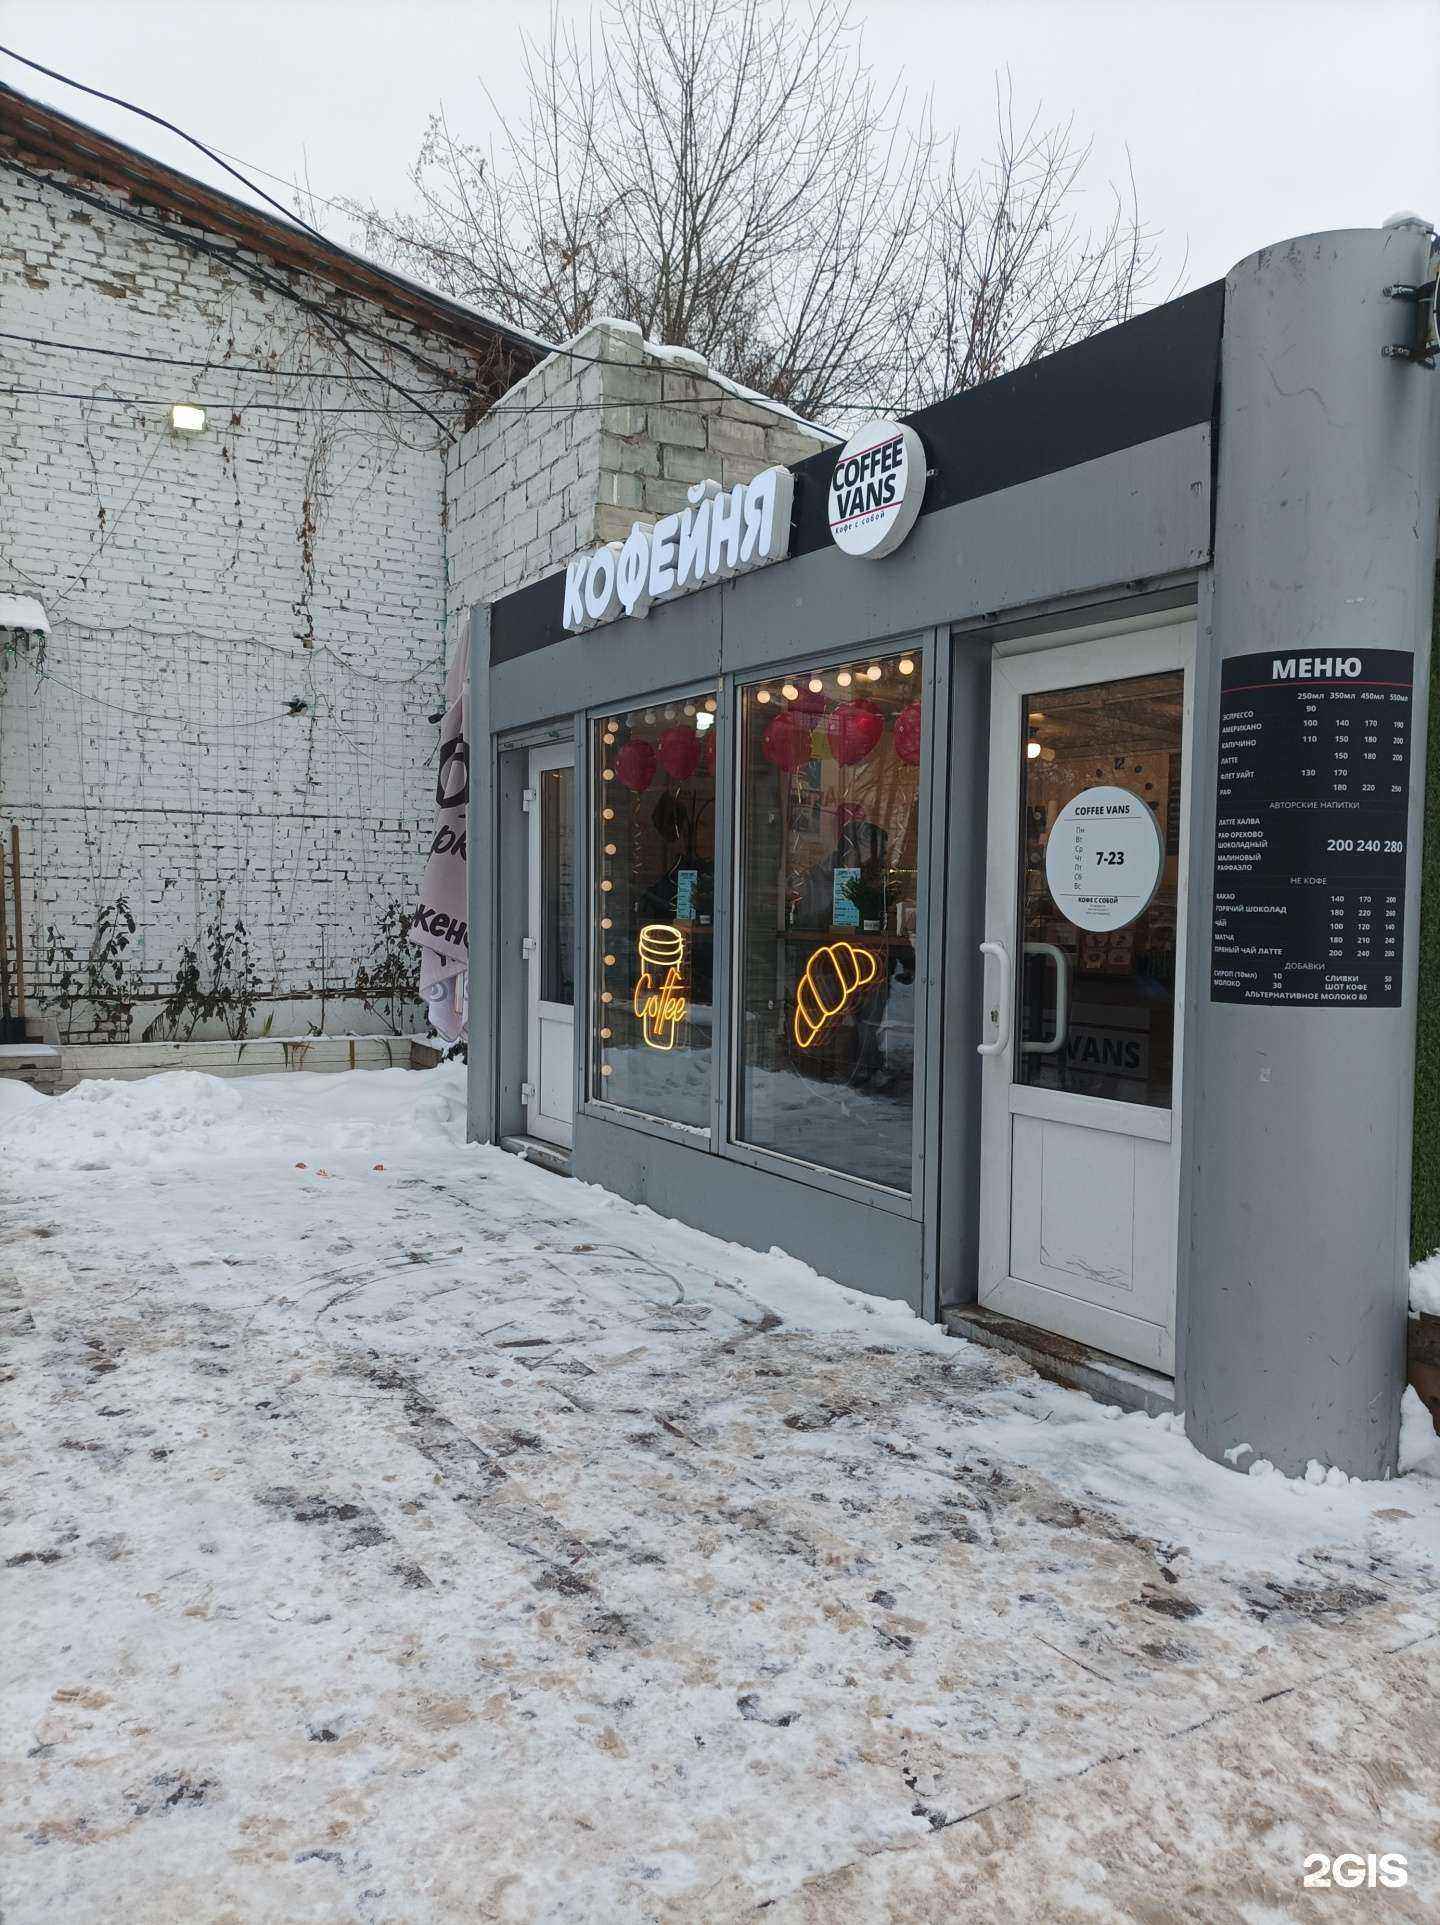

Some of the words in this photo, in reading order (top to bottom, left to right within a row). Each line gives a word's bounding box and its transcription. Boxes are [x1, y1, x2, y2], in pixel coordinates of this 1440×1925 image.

[832, 437, 904, 491] COFFEE
[836, 473, 897, 519] VANS
[562, 465, 793, 631] КОФЕЙНЯ
[1272, 657, 1362, 679] МЕНЮ
[1297, 692, 1325, 700] 250мл
[1329, 692, 1356, 700] 350мл
[1360, 692, 1385, 701] 450мл
[1222, 710, 1254, 720] ЭСПРЕССО
[1222, 723, 1262, 733] АМЕРИКАНО
[1336, 719, 1350, 727] 140
[1302, 735, 1317, 743] 110
[1335, 735, 1349, 743] 150
[1393, 737, 1404, 745] 200
[1221, 756, 1238, 765] ЛАТТЕ
[1334, 752, 1348, 760] 150
[1392, 754, 1403, 762] 200
[1269, 801, 1318, 809] АВТОРСКИЕ
[1319, 801, 1360, 809] НАПИТКИ
[1075, 806, 1104, 816] COFFEE
[1106, 805, 1130, 815] VANS
[1236, 817, 1260, 825] ХАЛВА
[1218, 840, 1268, 849] ШОКОЛАДНЫЙ
[1327, 839, 1354, 851] 200
[1357, 840, 1381, 852] 240
[1383, 841, 1403, 853] 280
[1096, 851, 1125, 866] 7-23
[1218, 852, 1261, 861] МАЛИНОВЫЙ
[1304, 877, 1327, 885] КОФЕ
[1245, 906, 1287, 915] ШОКОЛАД
[1215, 918, 1227, 927] ЧАЙ
[1240, 946, 1257, 955] ЧАЙ
[1256, 948, 1283, 956] ЛАТТЕ
[1284, 962, 1326, 971] ДОБАВКИ
[1273, 972, 1282, 980] 10
[1214, 979, 1241, 988] МОЛОКО
[1245, 990, 1319, 1000] АЛЬТЕРНАТИВНОЕ
[1320, 993, 1357, 1001] МОЛОКО
[634, 966, 687, 1036] Coffee
[1065, 1035, 1140, 1069] VANS
